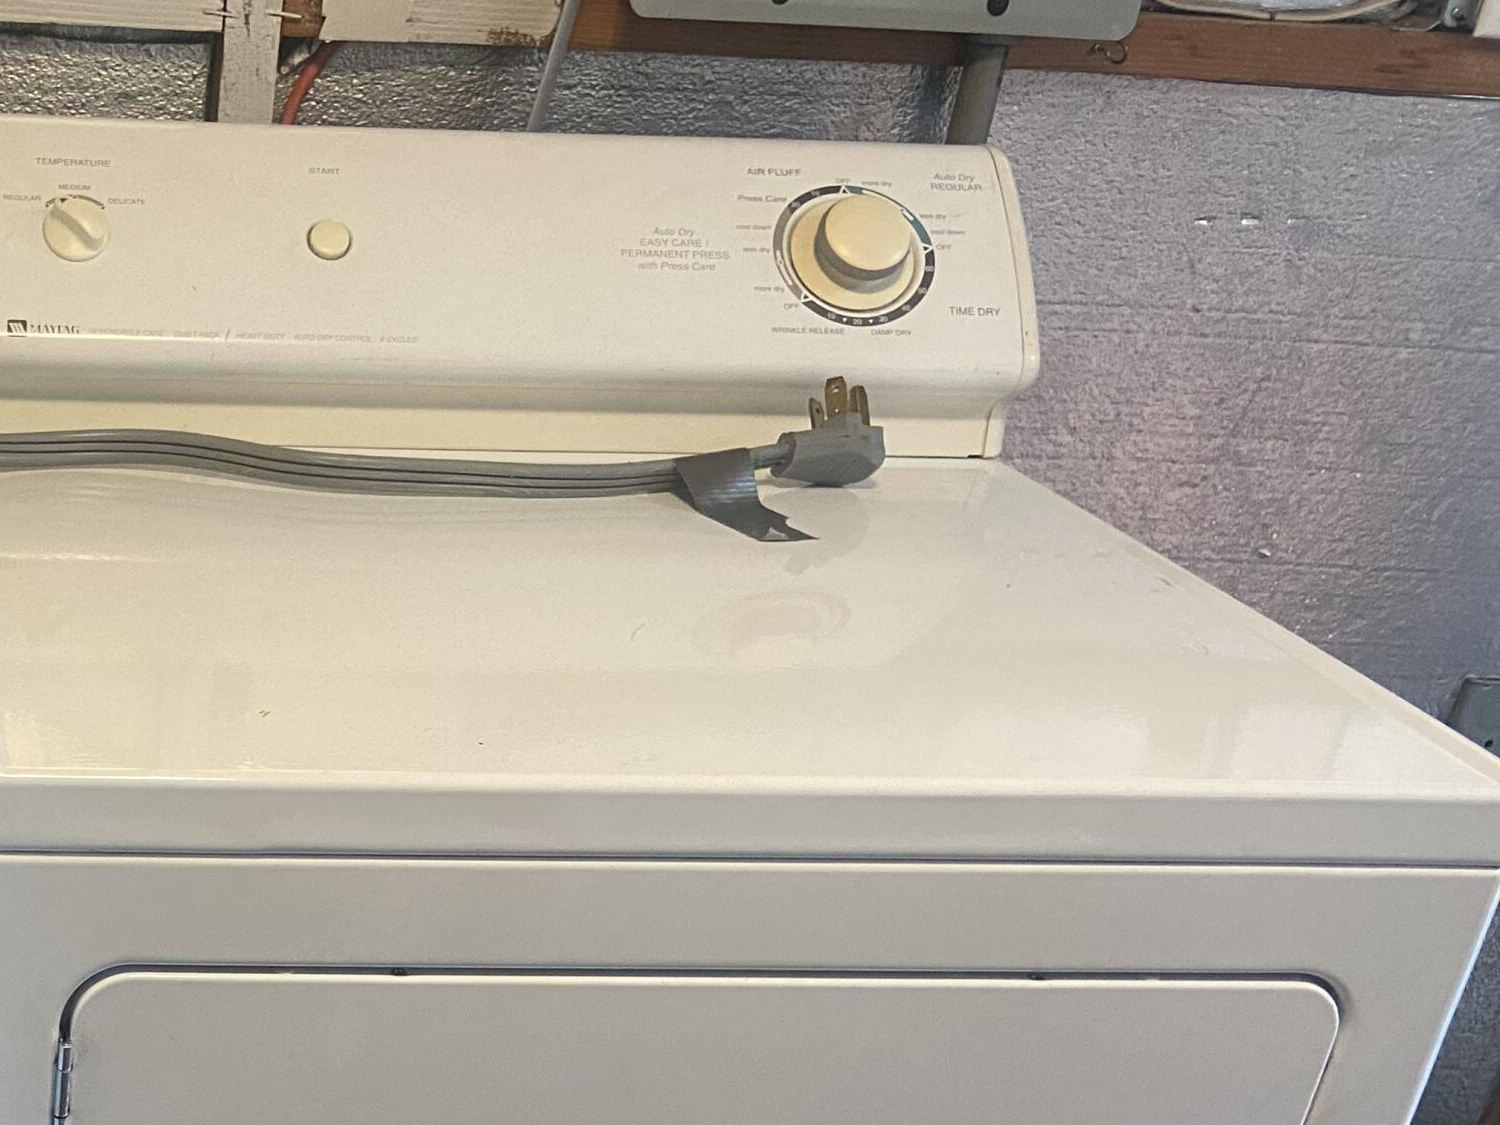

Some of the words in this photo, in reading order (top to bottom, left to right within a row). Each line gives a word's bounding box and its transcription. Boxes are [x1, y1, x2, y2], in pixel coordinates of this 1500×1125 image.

[36, 157, 112, 168] TEMPERATURE
[308, 167, 341, 176] START
[746, 168, 765, 176] AIR
[767, 168, 801, 177] FLUFF
[933, 173, 956, 182] Auto
[958, 174, 975, 184] Dry
[58, 183, 92, 191] MEDIUM
[930, 183, 982, 192] REGULAR
[2, 193, 42, 202] REGULAR
[107, 197, 146, 206] DELICATE
[737, 194, 763, 203] Press
[764, 194, 788, 203] Care
[653, 227, 675, 236] Auto
[677, 228, 695, 237] Dry
[639, 238, 669, 247] EASY
[671, 239, 702, 248] CARE
[620, 248, 690, 260] PERMANENT
[692, 250, 731, 260] PRESS
[638, 261, 658, 271] with
[660, 262, 690, 271] Press
[691, 262, 716, 272] Care
[783, 303, 800, 311] OFF
[948, 305, 975, 317] TIME
[977, 306, 1001, 318] DRY
[29, 323, 80, 335] MAYTAG
[771, 326, 808, 335] WRINKLE
[808, 327, 845, 336] RELEASE
[870, 328, 894, 336] DAMP
